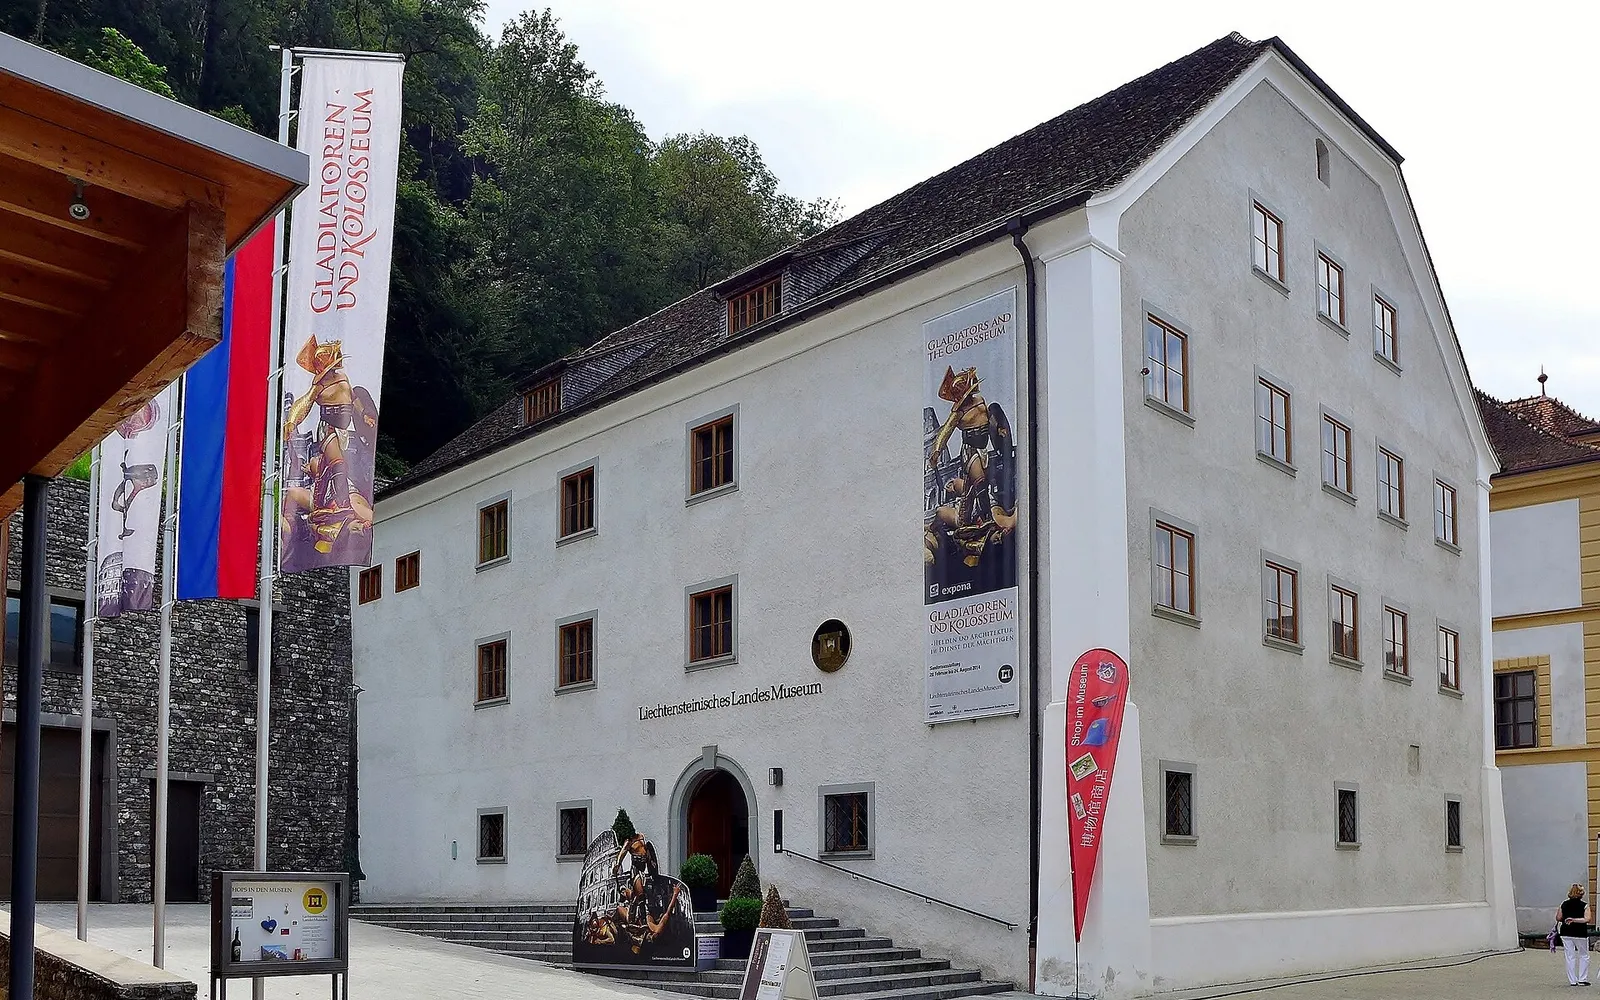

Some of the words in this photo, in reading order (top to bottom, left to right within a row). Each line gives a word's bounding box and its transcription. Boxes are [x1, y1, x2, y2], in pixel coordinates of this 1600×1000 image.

[341, 88, 378, 258] KOLOSSEUM
[310, 102, 347, 314] GLADIATOREN
[336, 261, 359, 311] UND
[927, 321, 989, 351] GLADIATORS
[991, 313, 1012, 328] AND
[927, 349, 944, 361] THE
[945, 325, 1006, 355] COLOSSEUM
[941, 582, 972, 595] expona
[929, 598, 1007, 623] GLADIATOREN
[949, 609, 1014, 635] KOLOSSEUM
[638, 695, 730, 720] Liechtensteinisches
[731, 688, 770, 706] Landes
[771, 682, 823, 700] Museum
[1076, 664, 1088, 704] Museum
[1075, 707, 1083, 718] im
[1071, 720, 1083, 746] Shop
[1080, 769, 1108, 848] 博物馆商店
